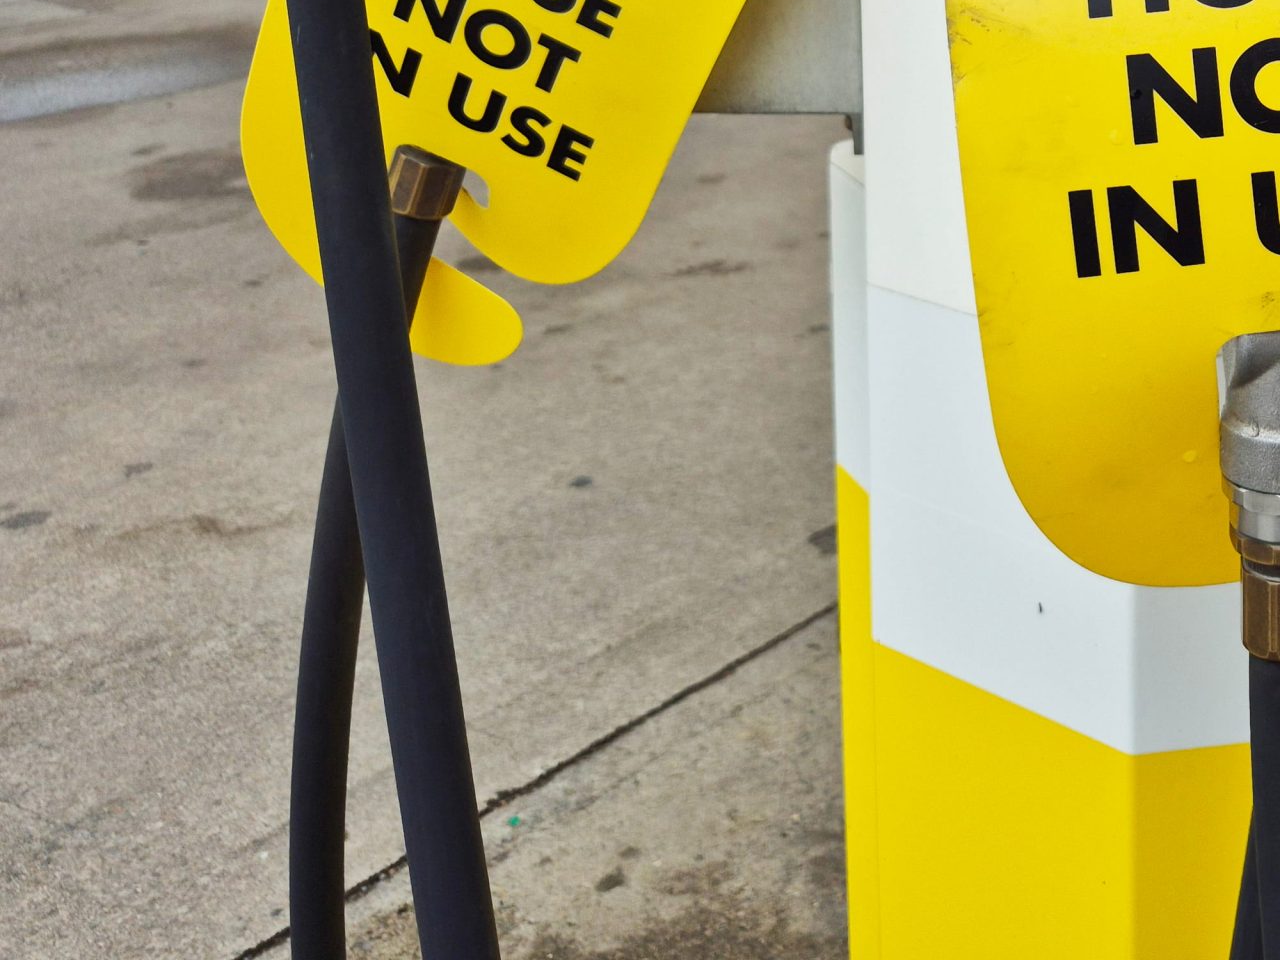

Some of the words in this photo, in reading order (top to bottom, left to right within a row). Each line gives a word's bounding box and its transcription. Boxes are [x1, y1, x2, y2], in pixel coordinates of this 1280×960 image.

[369, 28, 423, 98] N
[447, 72, 595, 182] USE
[1068, 179, 1206, 278] IN
